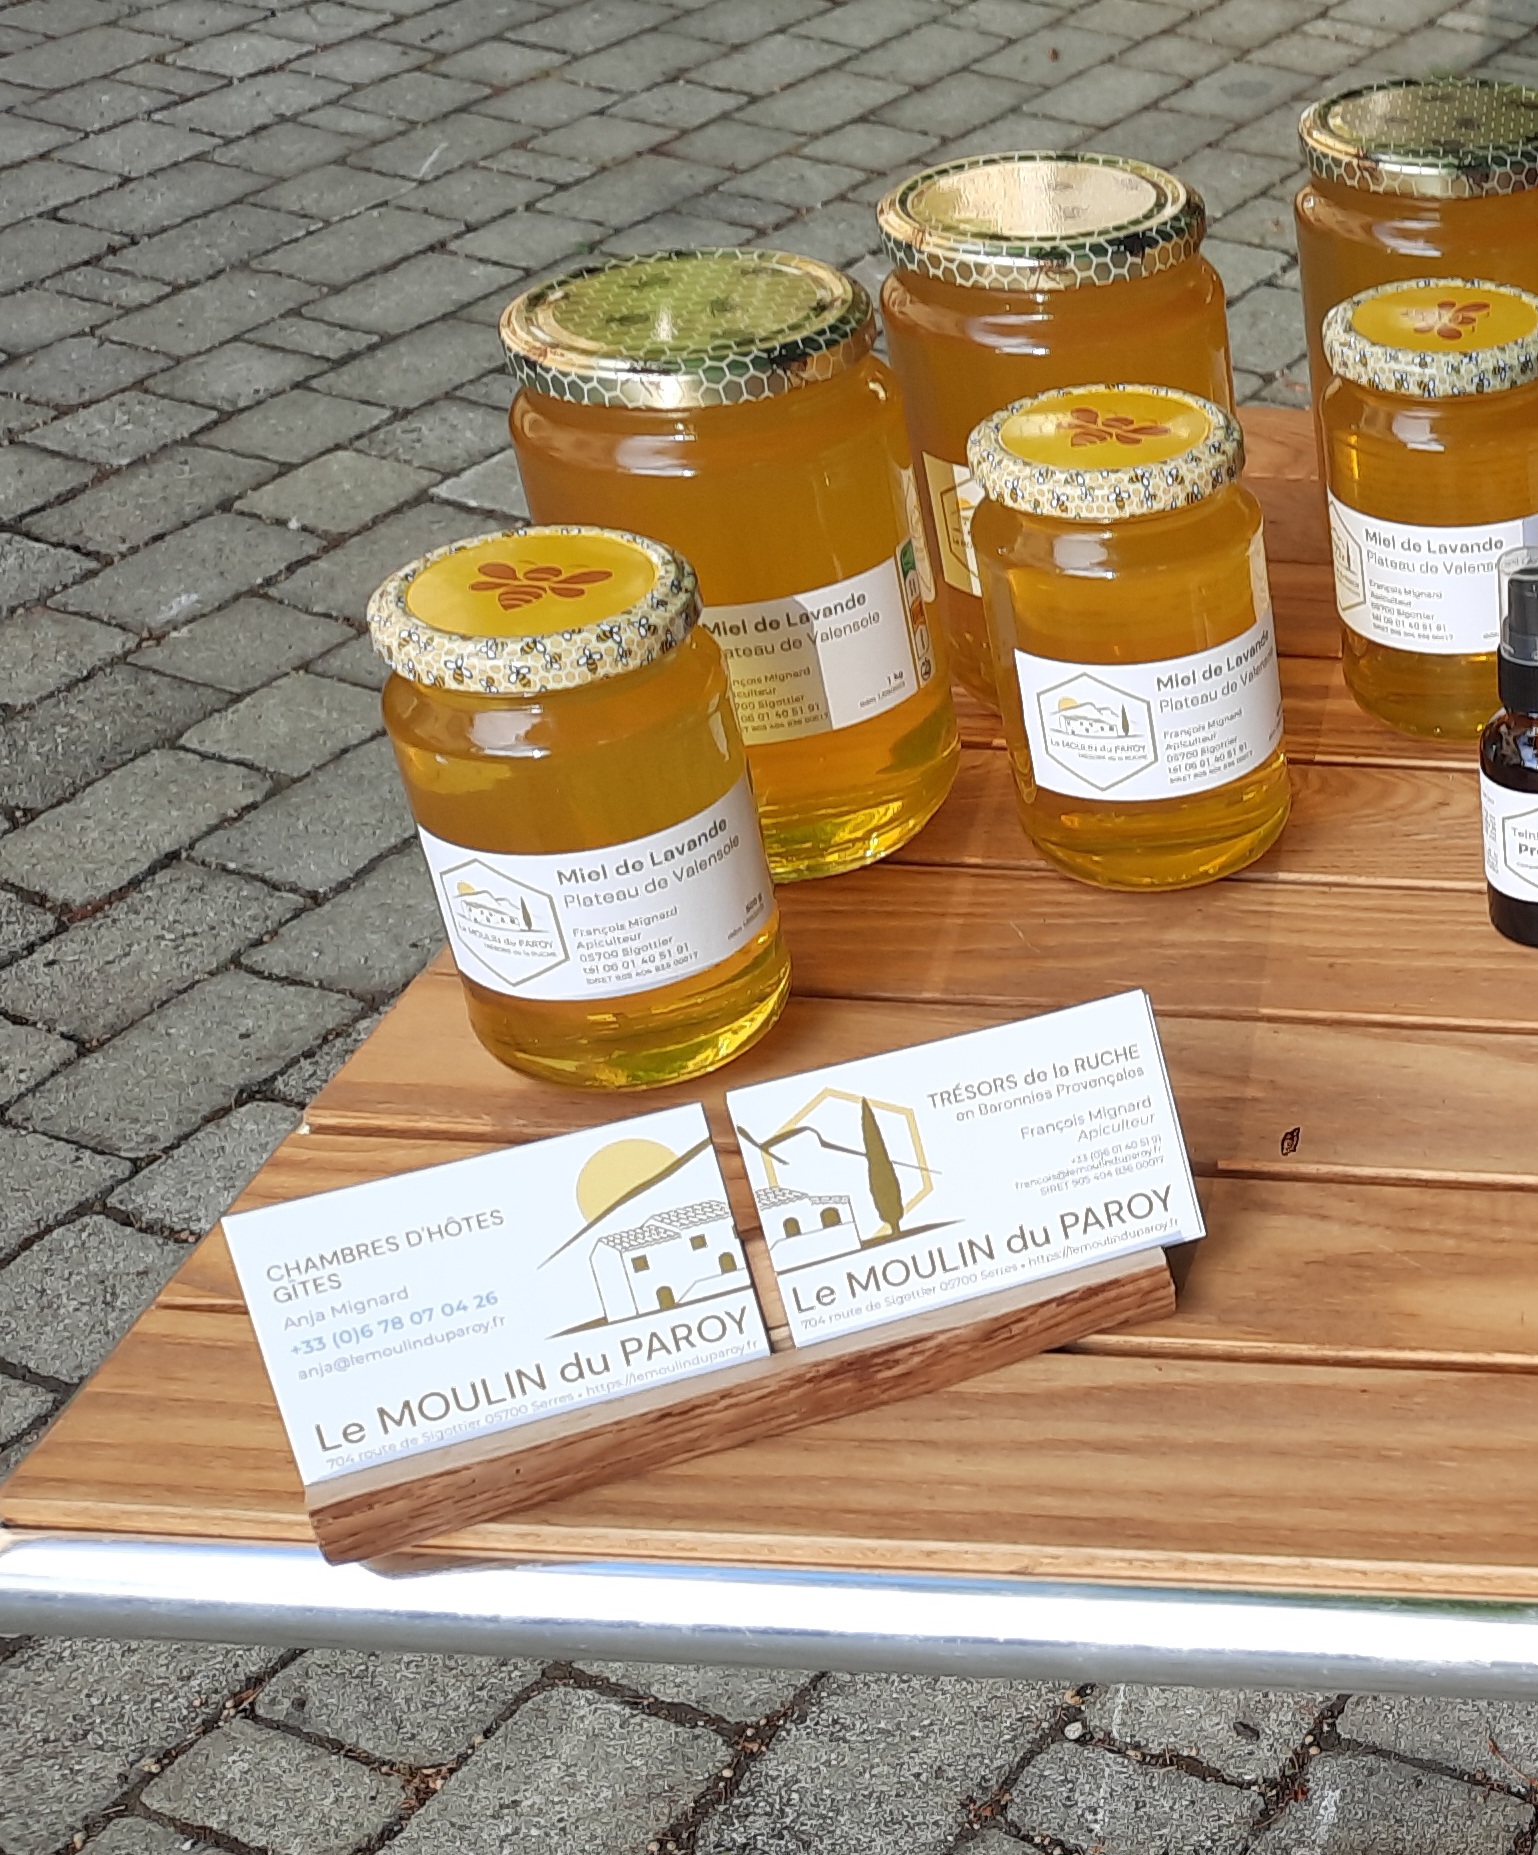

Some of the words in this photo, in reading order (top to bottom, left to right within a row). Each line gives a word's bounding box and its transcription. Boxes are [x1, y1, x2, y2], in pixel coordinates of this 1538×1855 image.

[1365, 528, 1395, 550] Miel
[1401, 536, 1421, 554] de
[1427, 536, 1503, 555] Lavande
[1366, 549, 1415, 573] Plateau
[1420, 561, 1438, 575] de
[702, 617, 747, 637] Miel
[754, 615, 780, 633] de
[786, 592, 867, 627] Lavande
[780, 637, 802, 652] de
[807, 611, 880, 644] Valensole
[1156, 670, 1196, 692] Miel
[1202, 664, 1222, 681] de
[1160, 690, 1217, 713] Plateau
[1221, 681, 1237, 696] de
[557, 864, 608, 886] Miel
[615, 859, 644, 877] de
[650, 818, 727, 867] Lavande
[564, 886, 640, 909] Plateau
[644, 877, 669, 894] de
[673, 834, 740, 882] Valensole
[573, 922, 626, 936] François
[628, 905, 678, 928] Mignard
[576, 932, 642, 950] Apiculteur
[927, 1074, 1018, 1109] TRÉSORS
[1024, 1068, 1048, 1086] de
[1053, 1064, 1069, 1078] la
[1074, 1044, 1140, 1073] RUCHE
[956, 1110, 974, 1122] en
[979, 1091, 1052, 1115] Baronnies
[1056, 1066, 1144, 1097] Provençales
[1020, 1114, 1085, 1140] François
[1088, 1095, 1152, 1123] Mignard
[1078, 1113, 1154, 1142] Apiculteur
[266, 1235, 400, 1282] CHAMBRES
[405, 1209, 504, 1248] D'HÔTES
[792, 1286, 836, 1313] Le
[846, 1234, 995, 1299] MOULIN
[1006, 1224, 1051, 1253] du
[1060, 1184, 1171, 1240] PAROY
[273, 1273, 342, 1303] GÎTES
[284, 1309, 326, 1330] Anja
[331, 1286, 409, 1318] Mignard
[801, 1316, 826, 1330] 704
[829, 1308, 862, 1324] route
[866, 1301, 881, 1313] de
[884, 1286, 936, 1307] Sigottier
[940, 1273, 977, 1291] 05700
[981, 1263, 1017, 1280] Serres
[291, 1337, 327, 1355] +33
[332, 1324, 373, 1349] (0)6
[377, 1316, 404, 1333] 78
[410, 1307, 434, 1325] 07
[441, 1300, 468, 1317] 04
[473, 1291, 498, 1309] 26
[298, 1315, 505, 1380] anja@lemoulinduparoy.fr
[315, 1422, 366, 1452] Le
[377, 1363, 547, 1435] MOULIN
[560, 1352, 610, 1383] du
[620, 1306, 746, 1367] PAROY
[326, 1455, 354, 1470] 704
[359, 1443, 396, 1461] route
[400, 1437, 418, 1450] de
[422, 1419, 480, 1441] Sigottier
[485, 1406, 528, 1424] 05700
[532, 1393, 574, 1411] Serres
